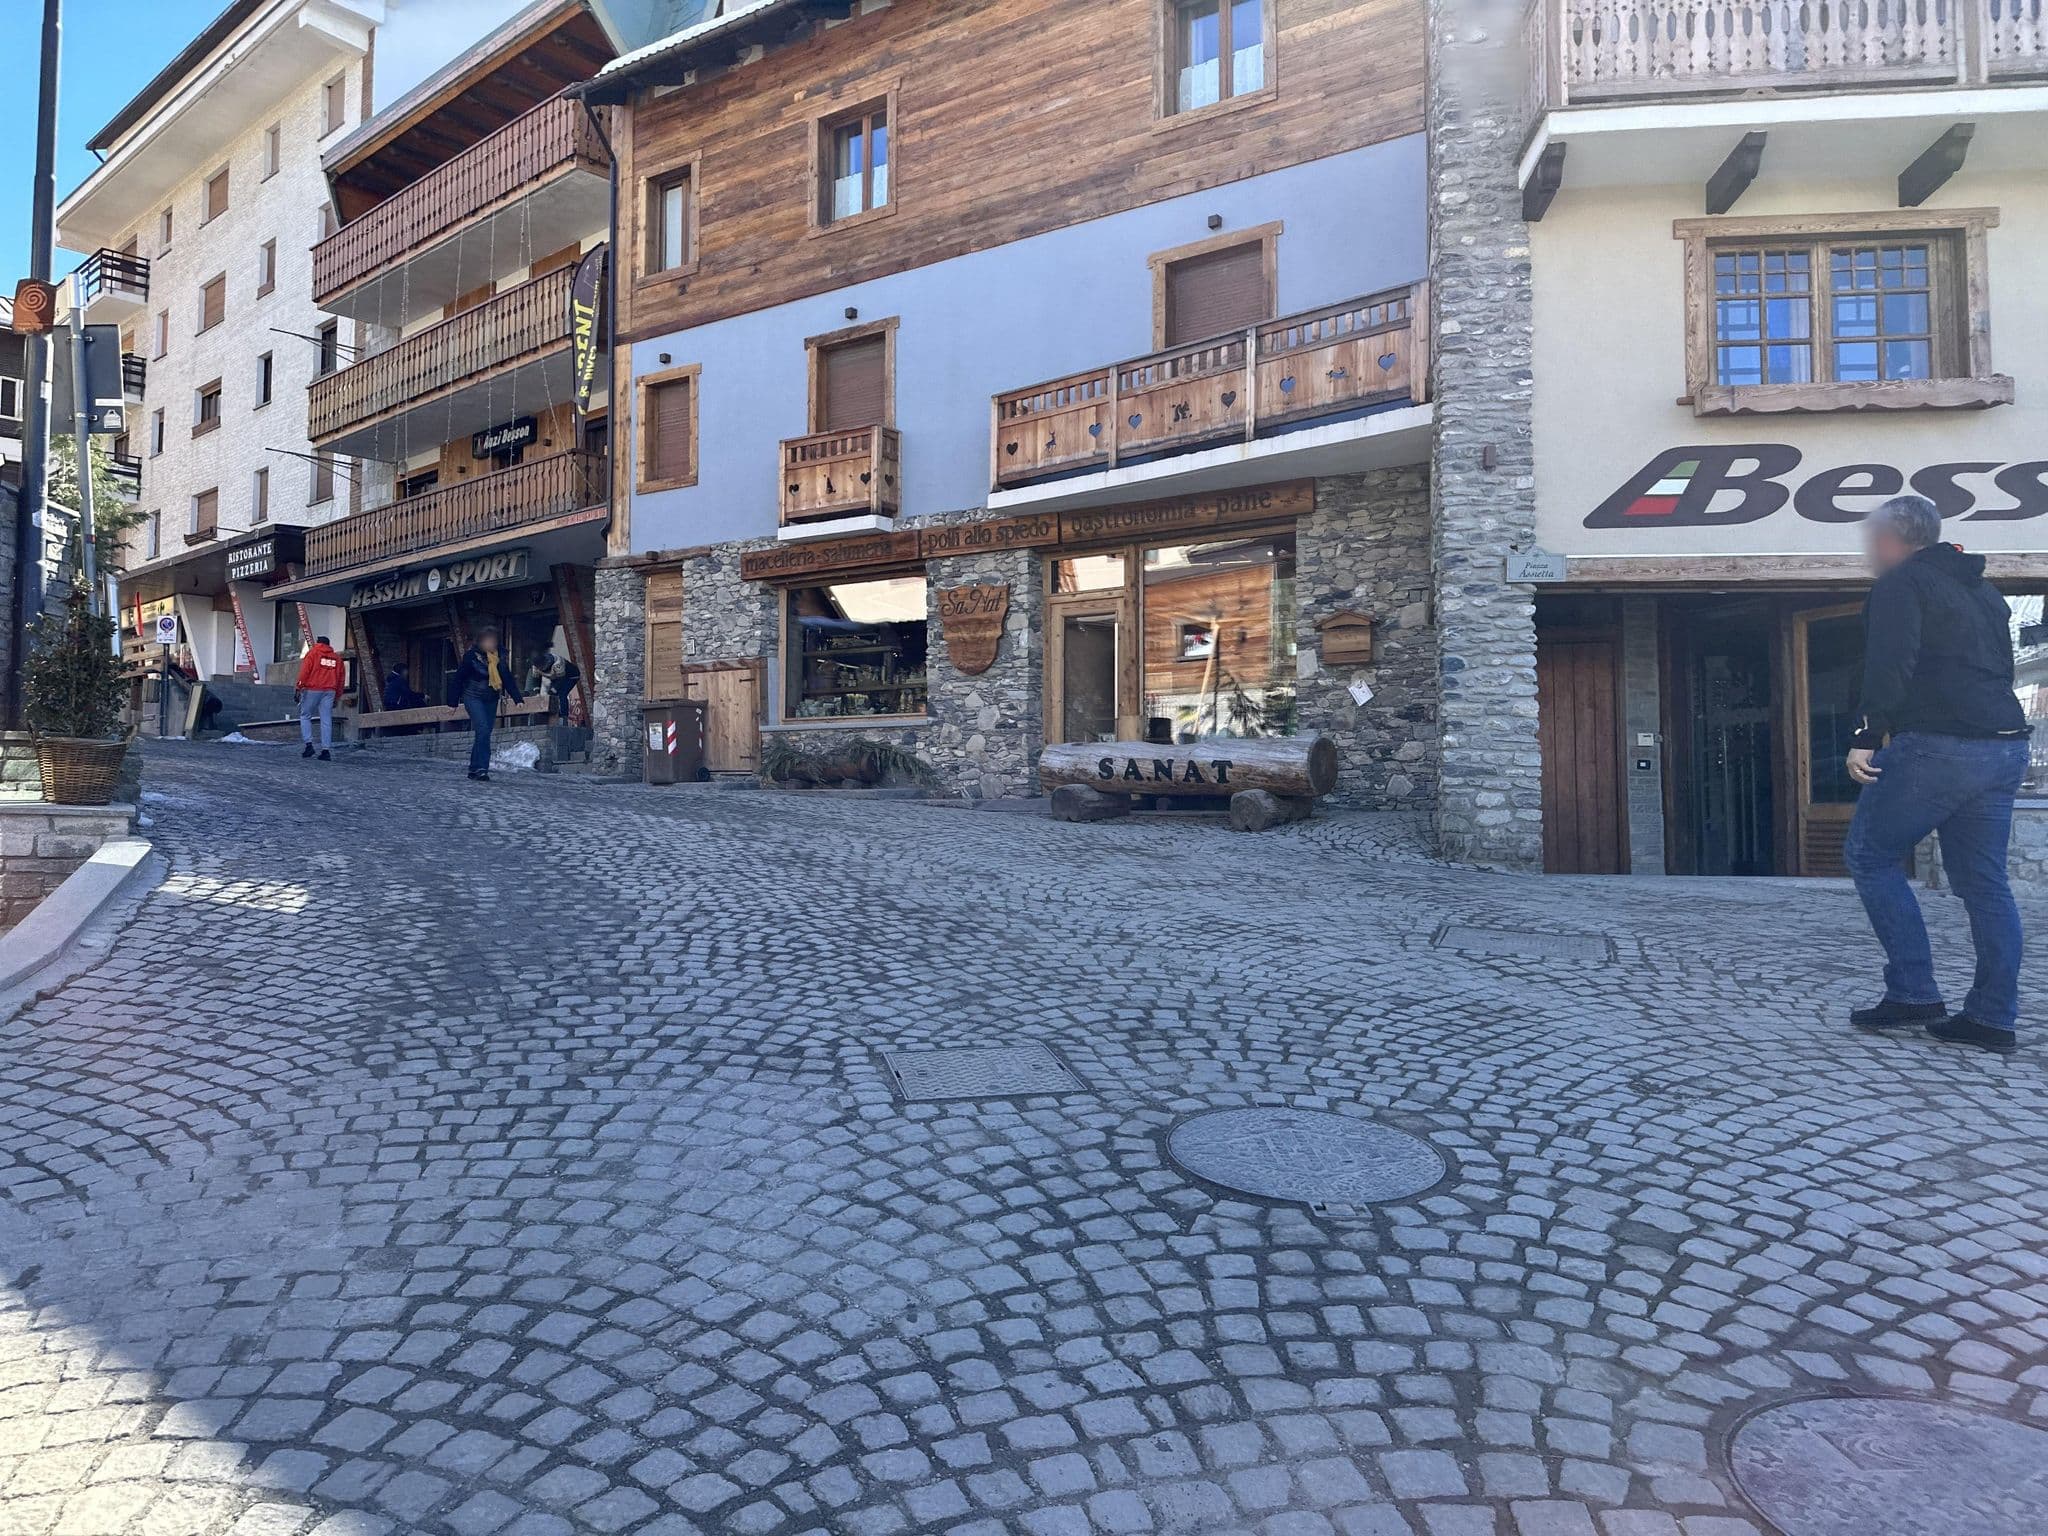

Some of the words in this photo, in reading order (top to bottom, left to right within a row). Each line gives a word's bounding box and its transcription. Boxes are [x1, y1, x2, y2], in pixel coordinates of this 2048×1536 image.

[501, 425, 530, 444] Besson
[1071, 503, 1196, 538] gastronomia
[1215, 492, 1272, 521] pane
[927, 526, 960, 554] polli
[964, 525, 992, 546] allo
[996, 517, 1049, 547] spiedo
[228, 542, 272, 564] RISTORANTE
[745, 547, 816, 572] macelleria
[823, 537, 894, 564] salumeria
[231, 559, 268, 579] PIZZERIA
[349, 576, 422, 608] BESSON
[447, 552, 522, 588] SPORT
[1519, 569, 1554, 578] Assietta
